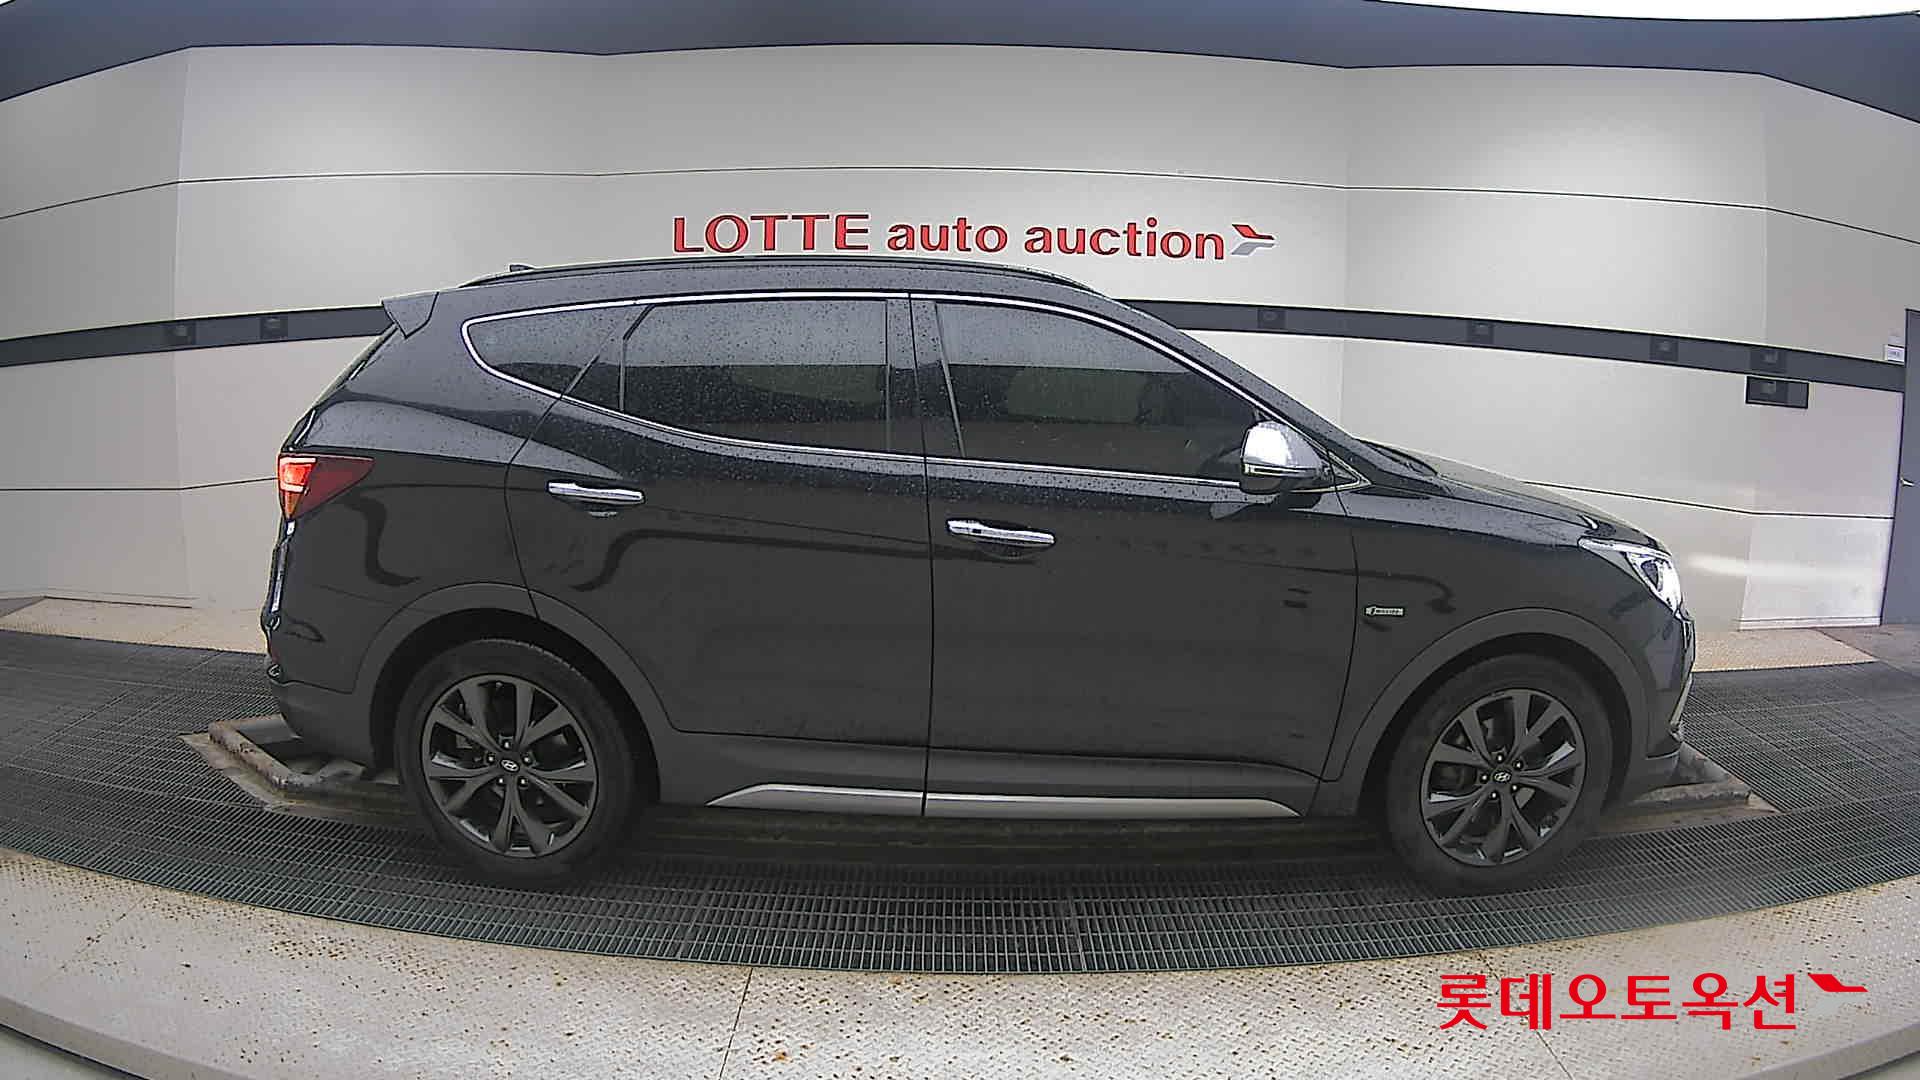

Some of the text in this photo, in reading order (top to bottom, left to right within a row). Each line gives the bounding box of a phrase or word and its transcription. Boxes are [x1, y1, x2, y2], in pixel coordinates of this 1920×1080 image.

[673, 214, 1225, 260] LOTTE auto auction
